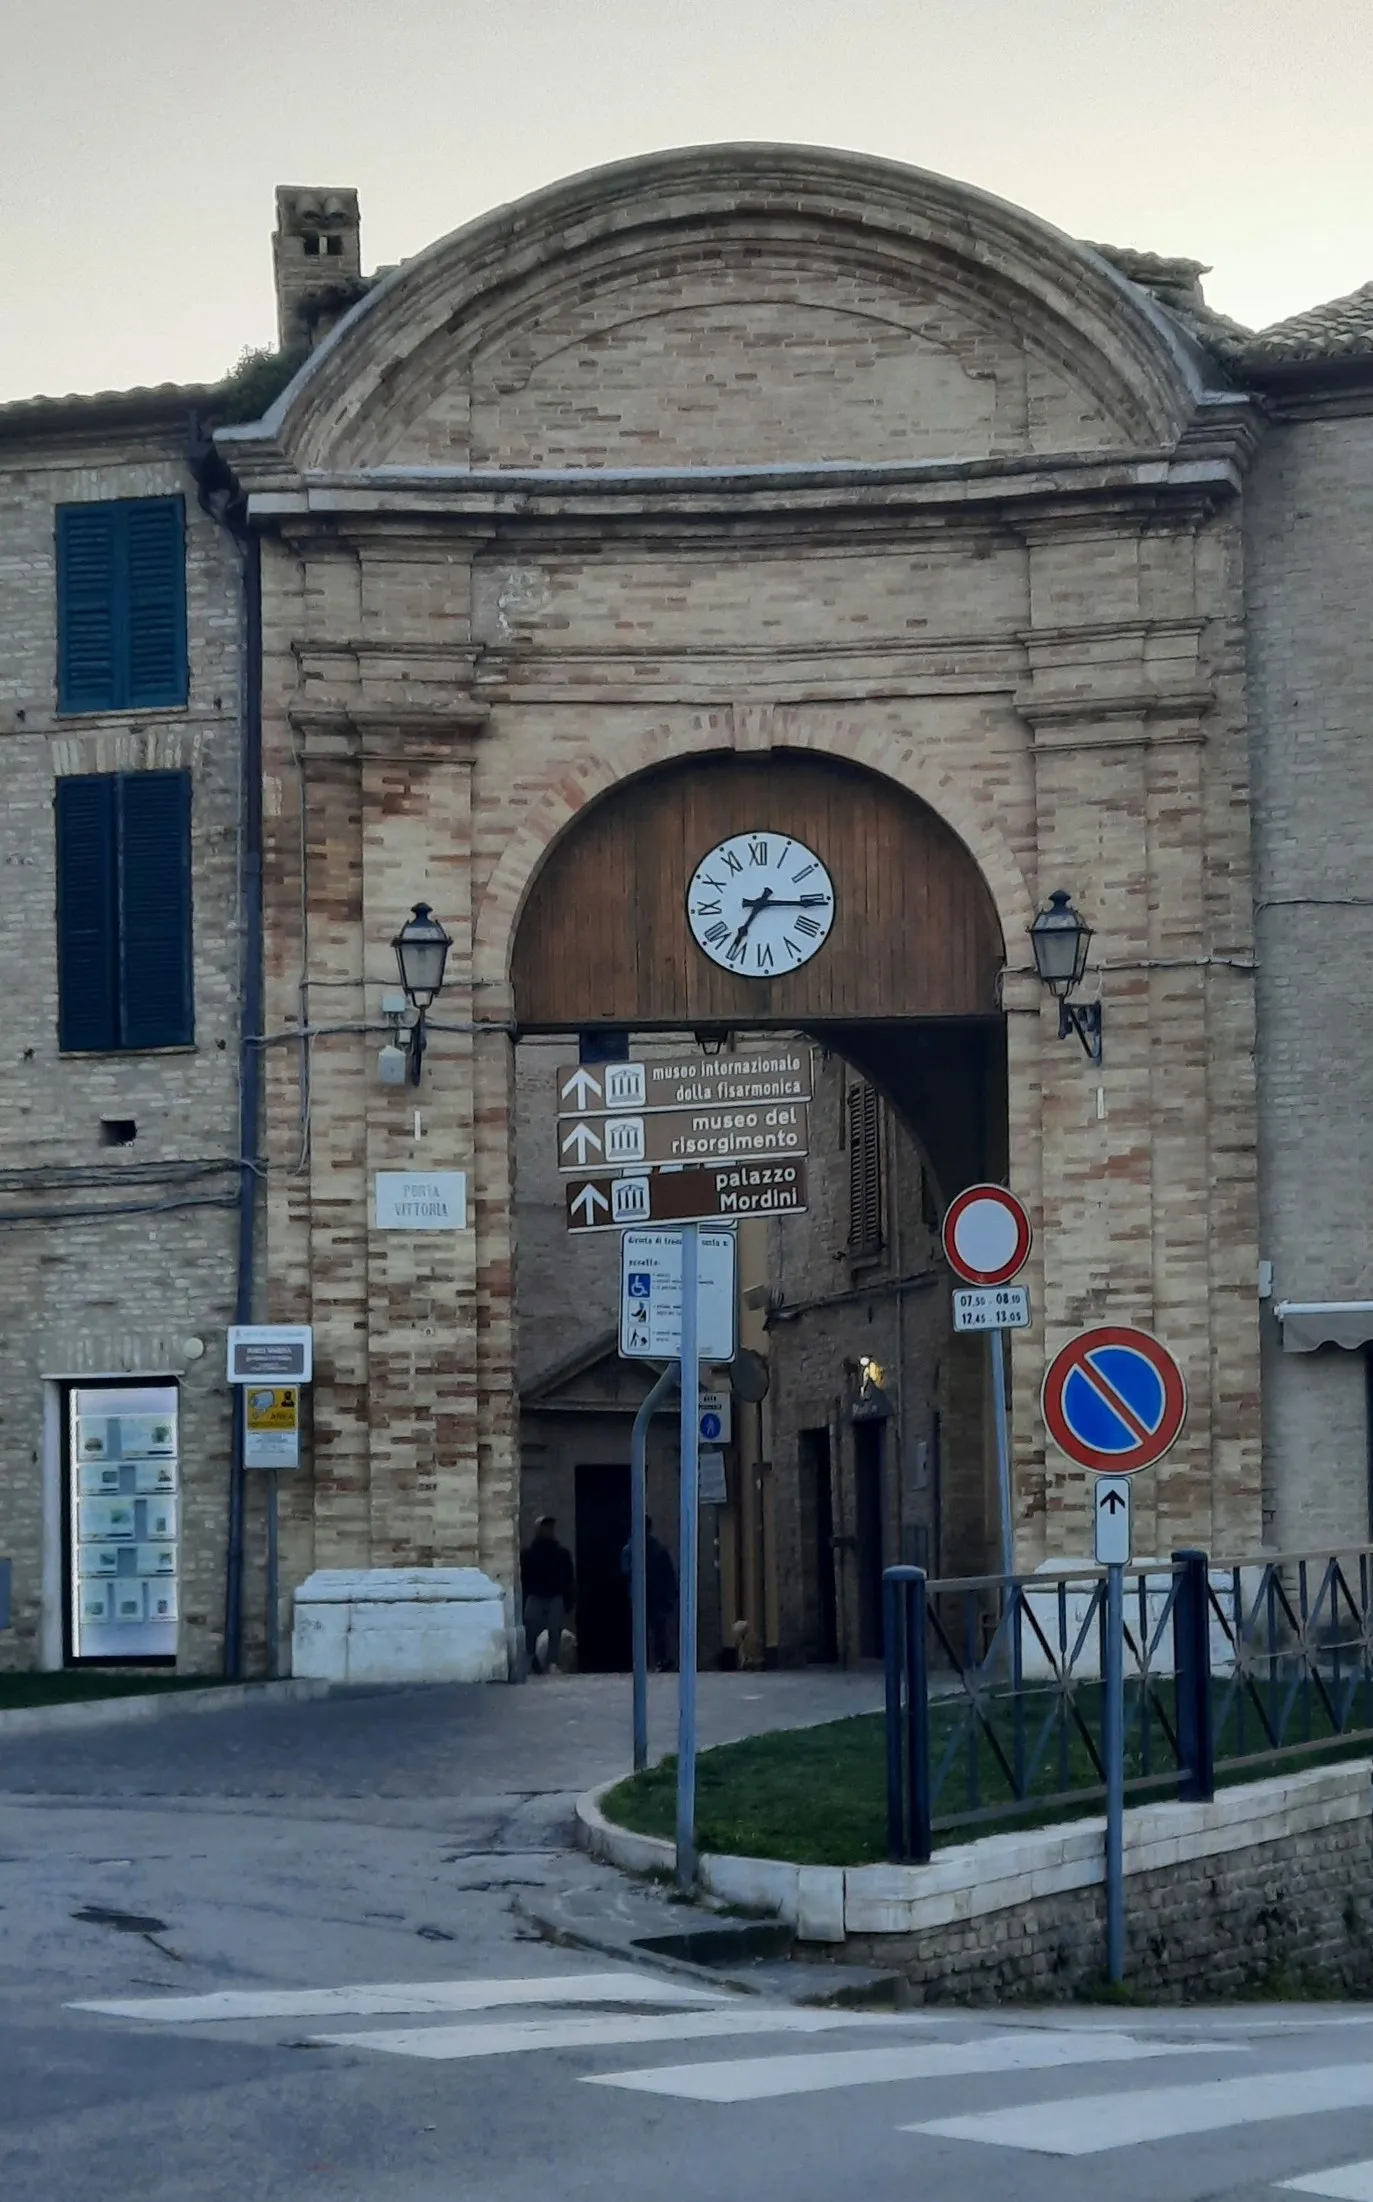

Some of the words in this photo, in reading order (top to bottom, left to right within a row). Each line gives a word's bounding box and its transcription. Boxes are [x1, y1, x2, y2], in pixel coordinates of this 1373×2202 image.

[721, 850, 743, 878] XI
[748, 842, 768, 866] XII
[702, 873, 727, 893] X
[791, 865, 815, 883] II
[697, 899, 722, 916] IX
[757, 943, 774, 968] VI
[783, 936, 802, 959] V
[652, 1065, 696, 1081] museo
[701, 1054, 800, 1077] internazionale
[676, 1083, 712, 1102] della
[717, 1077, 801, 1099] fisarmonica
[692, 1113, 758, 1132] museo
[765, 1106, 797, 1126] del
[671, 1129, 798, 1154] risorgimento
[716, 1167, 796, 1192] palazzo
[394, 1202, 448, 1217] VITTORIA
[720, 1187, 797, 1212] Mordini
